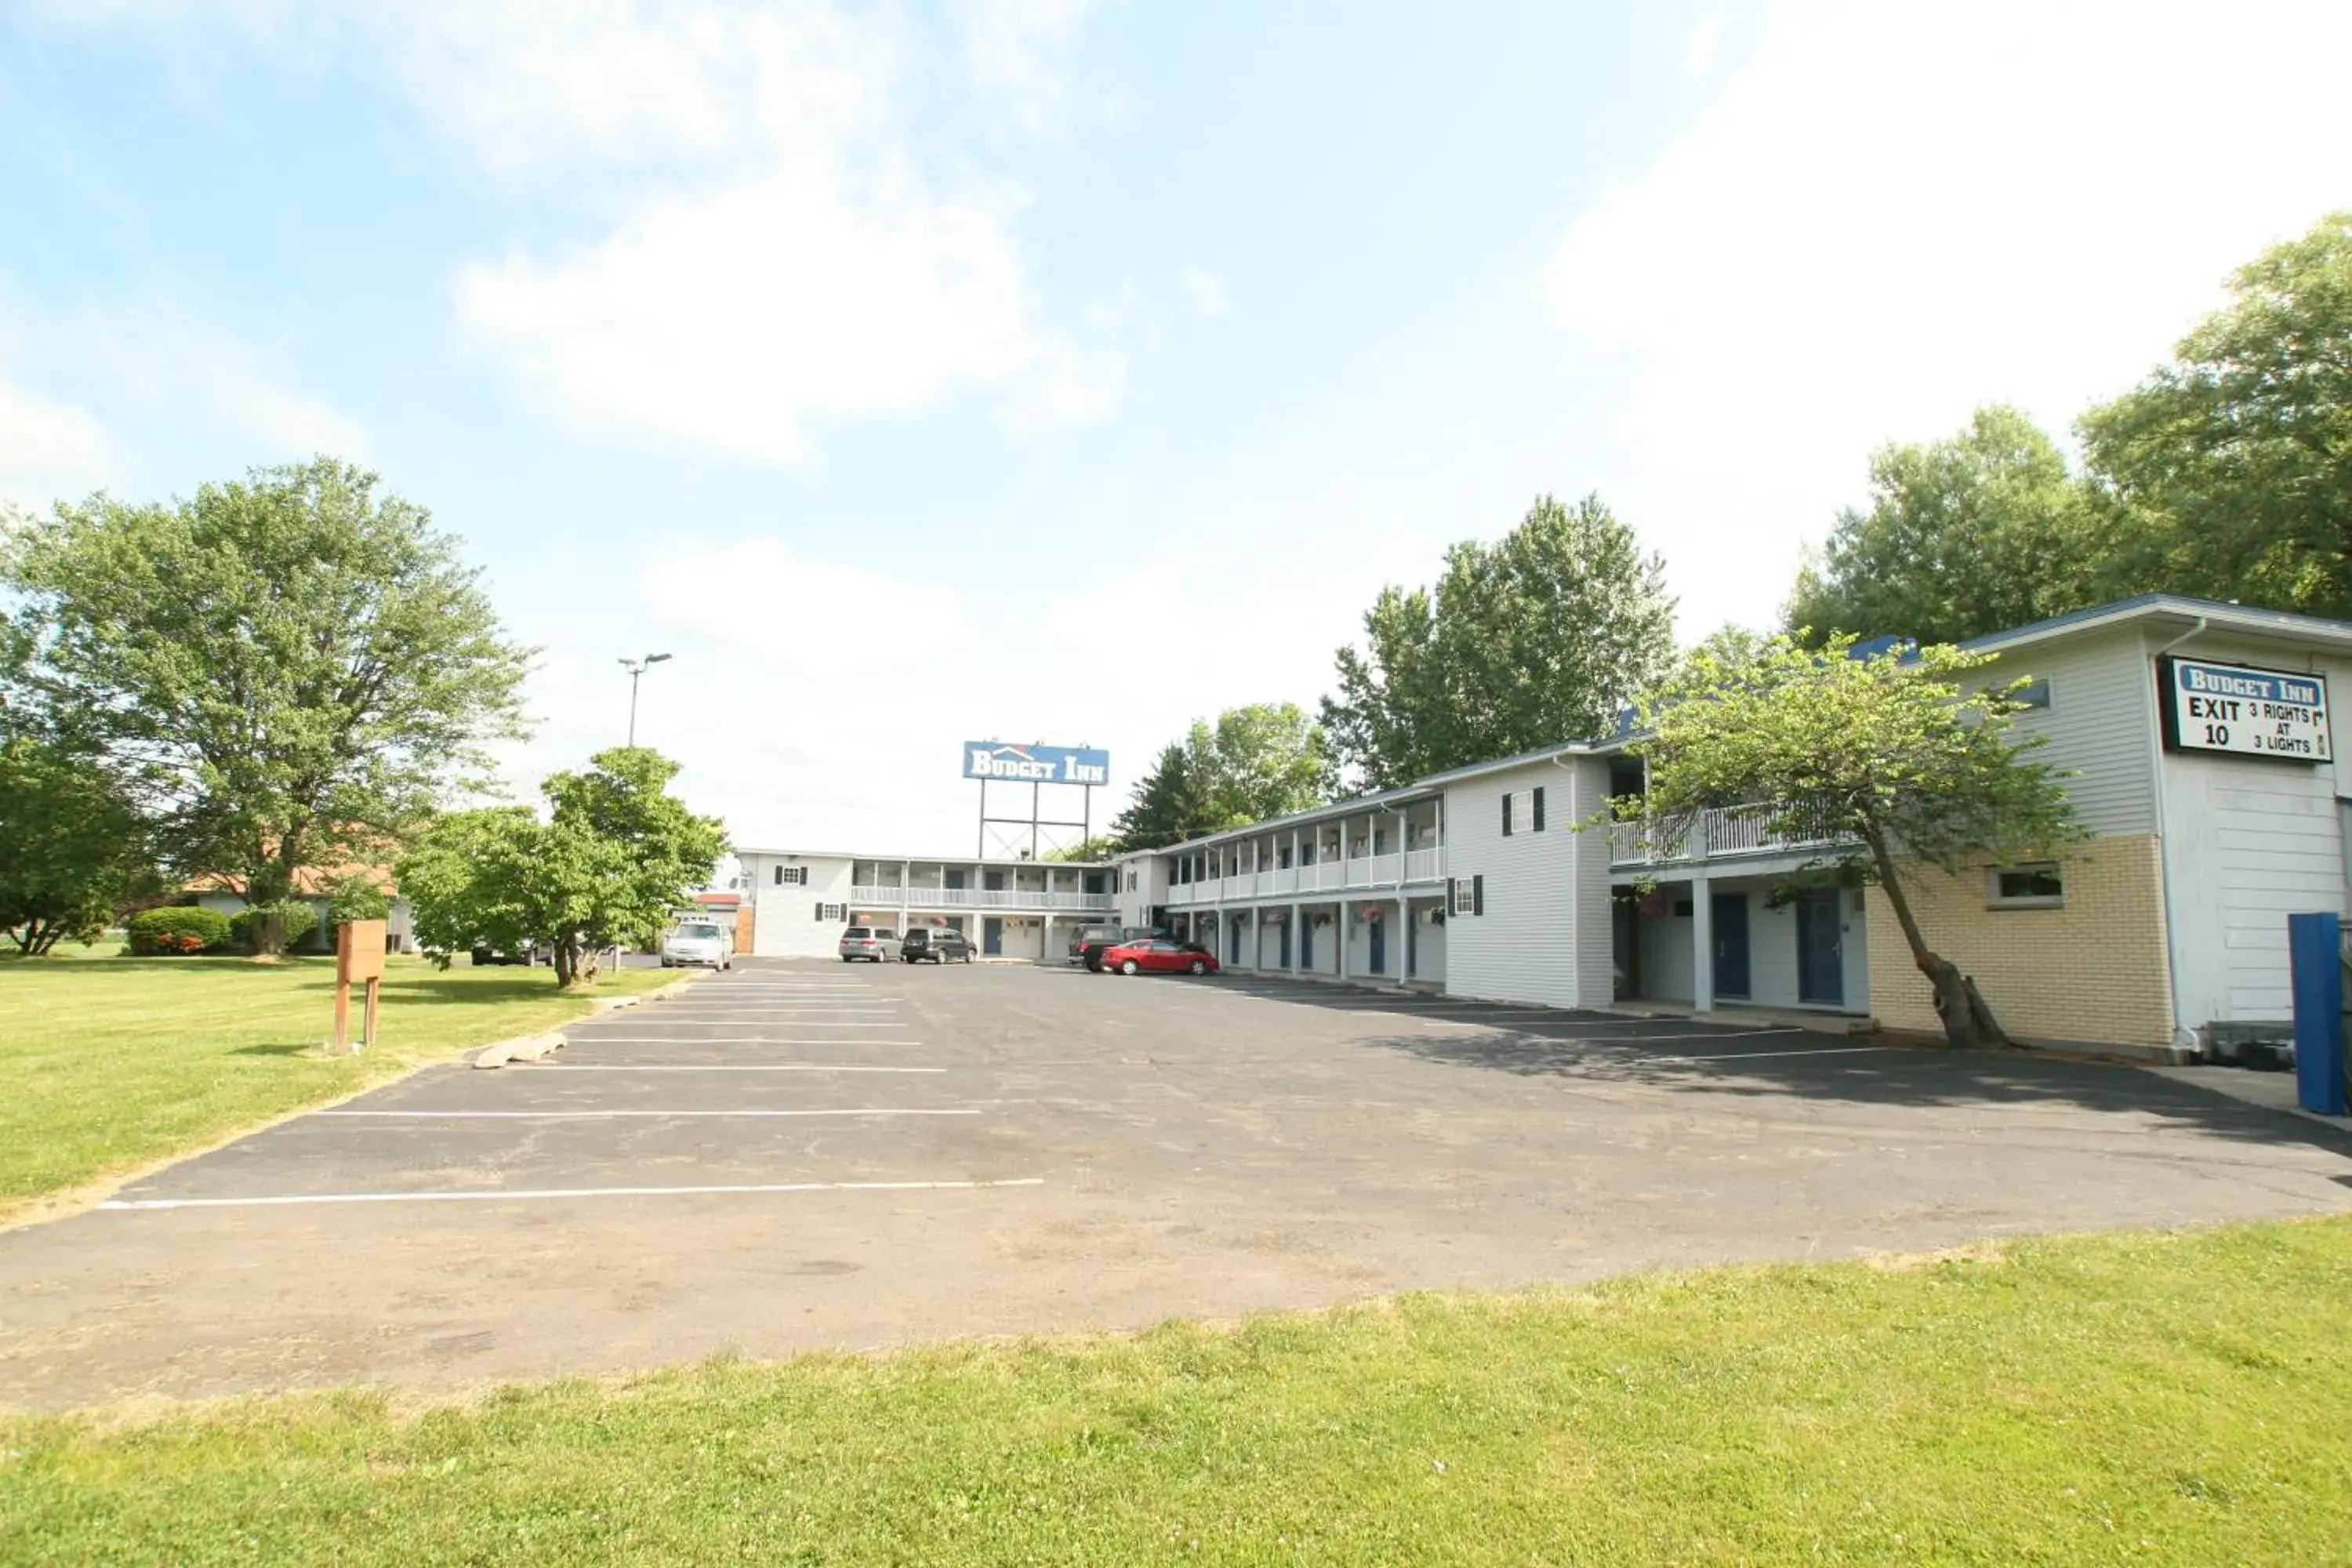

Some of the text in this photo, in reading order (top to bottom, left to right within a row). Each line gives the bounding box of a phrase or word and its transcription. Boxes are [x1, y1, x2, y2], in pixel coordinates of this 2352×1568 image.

[2188, 669, 2314, 702] BUDGET INN
[2189, 696, 2240, 721] EXIT
[2249, 702, 2309, 723] 3 RIGHTS
[2205, 724, 2229, 746] 10
[2276, 723, 2291, 735] AT
[2254, 735, 2310, 753] 3 LIGHTS
[971, 750, 1104, 782] BUDGET INN
